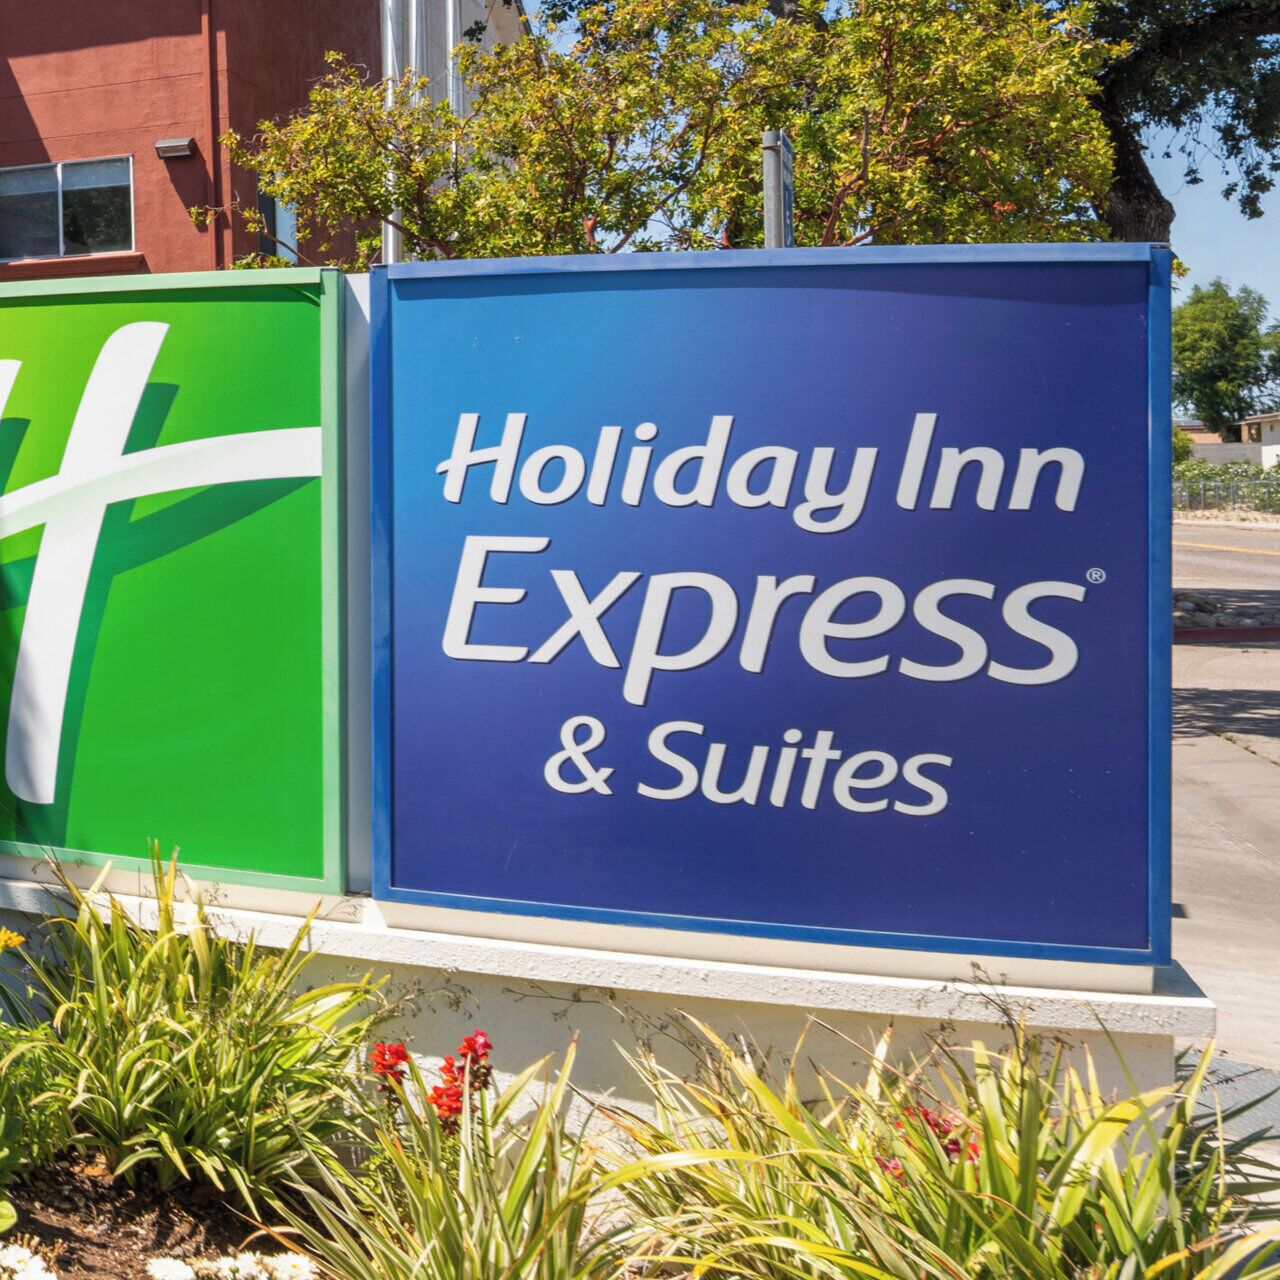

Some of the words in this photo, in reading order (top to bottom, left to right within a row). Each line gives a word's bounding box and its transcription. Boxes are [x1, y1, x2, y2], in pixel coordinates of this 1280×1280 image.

[436, 412, 878, 533] Holiday
[896, 412, 1086, 513] Inn
[543, 715, 614, 795] &
[637, 720, 953, 816] Suites
